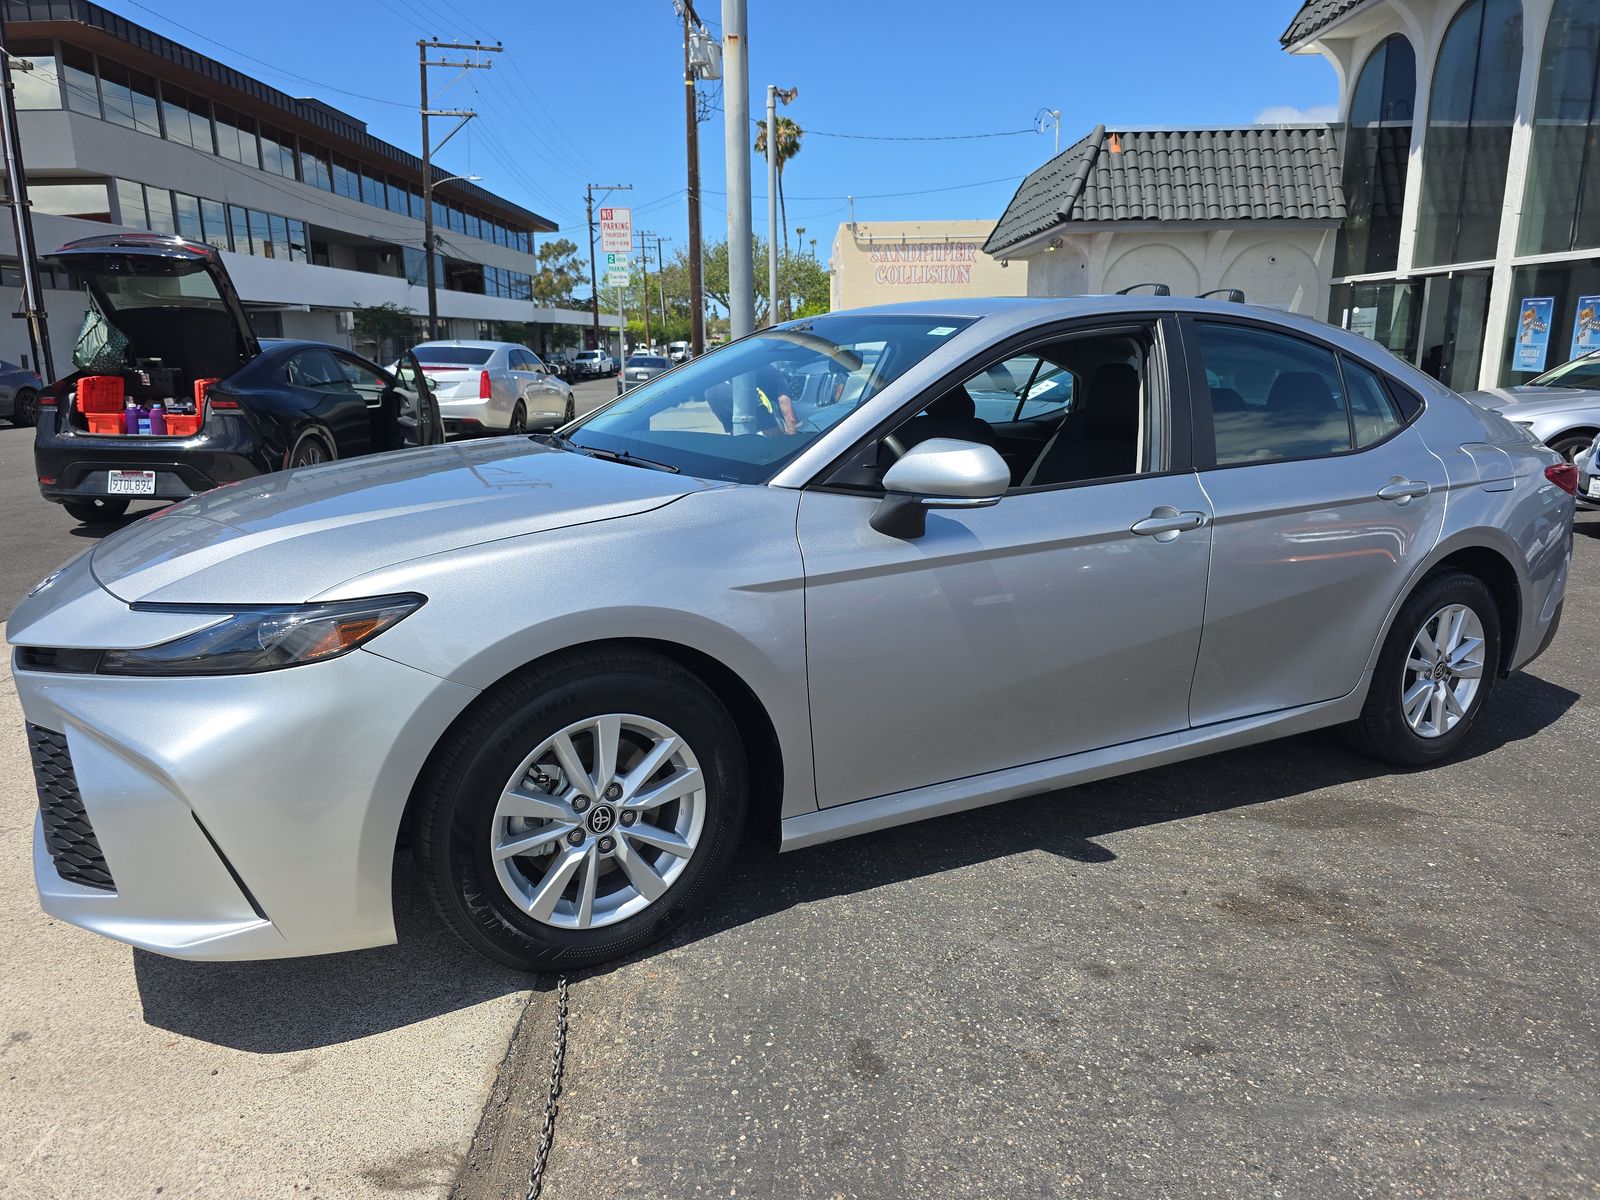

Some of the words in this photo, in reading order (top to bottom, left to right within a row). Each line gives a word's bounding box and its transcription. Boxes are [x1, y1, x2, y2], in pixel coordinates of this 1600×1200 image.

[601, 209, 612, 220] NO
[603, 222, 629, 230] PARKING
[870, 243, 976, 262] SANDPIPER
[609, 254, 615, 263] 2
[875, 265, 971, 284] COLLISION
